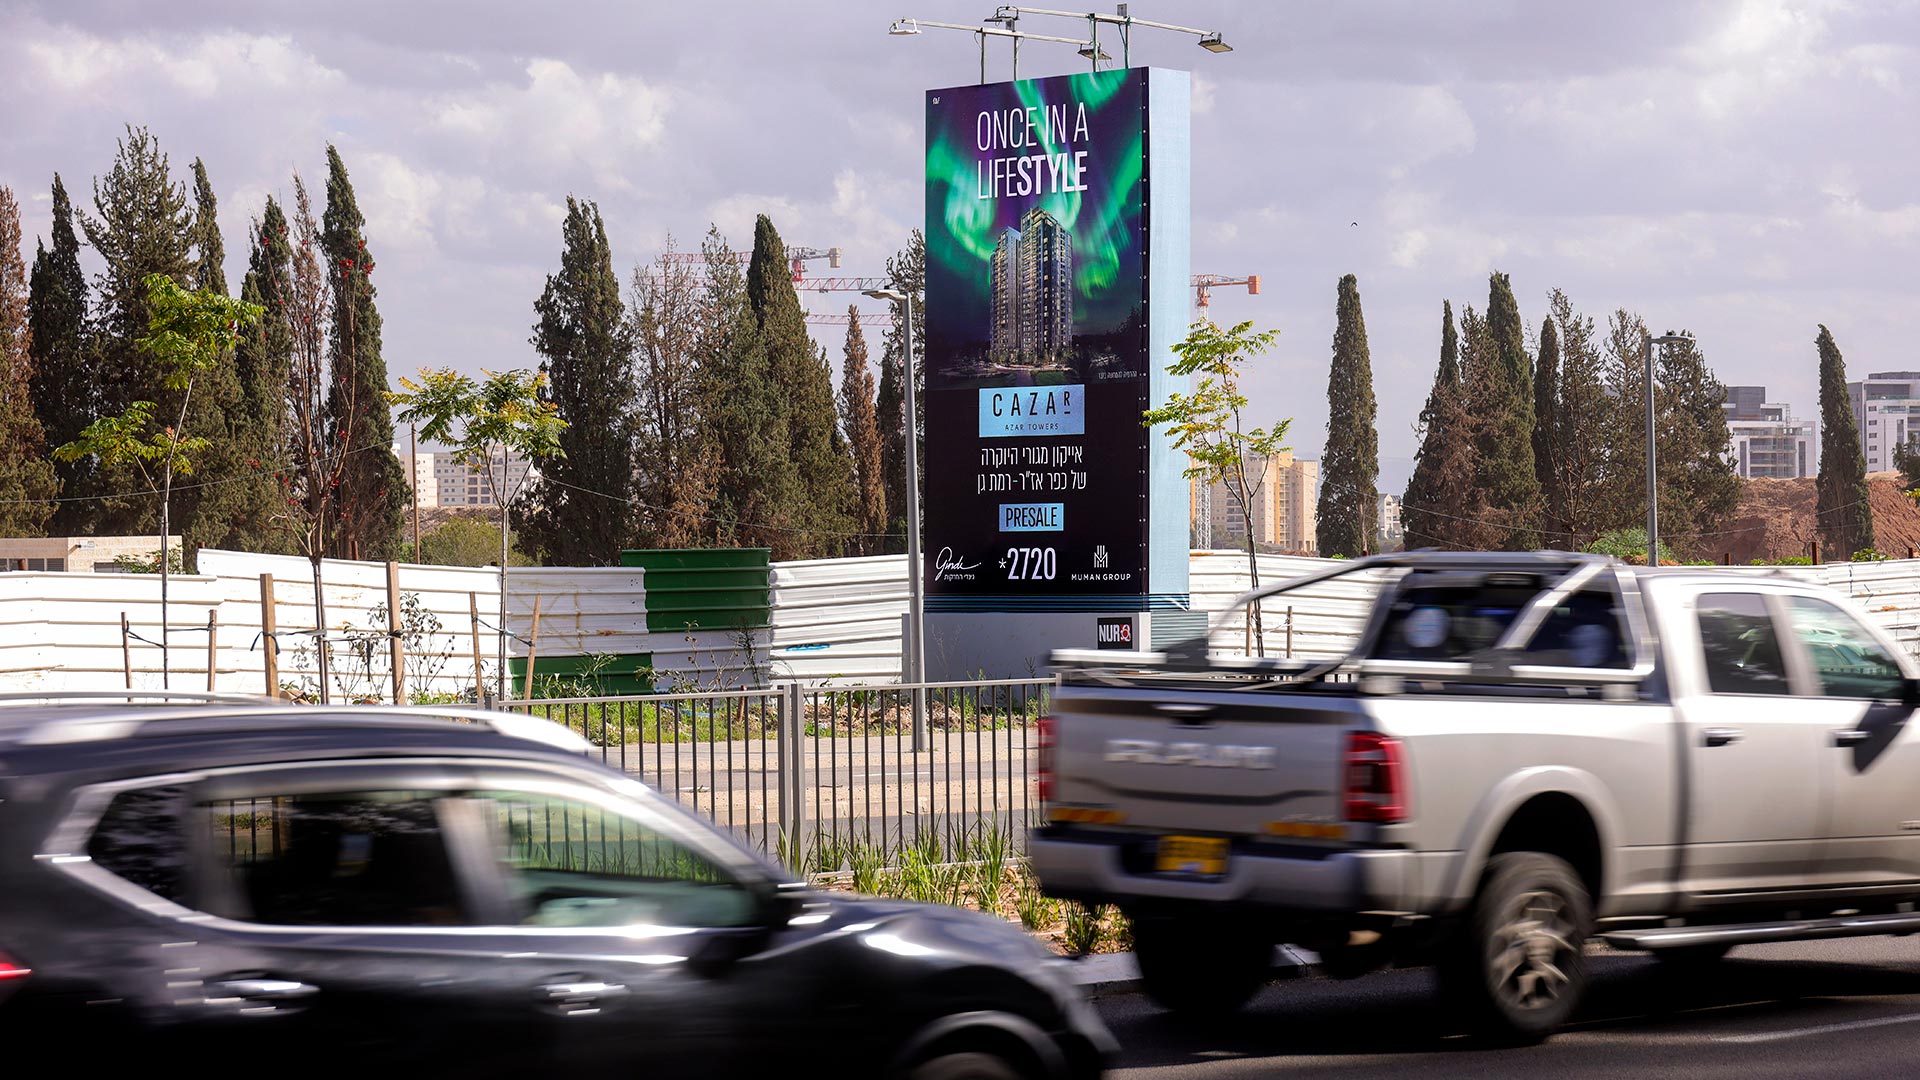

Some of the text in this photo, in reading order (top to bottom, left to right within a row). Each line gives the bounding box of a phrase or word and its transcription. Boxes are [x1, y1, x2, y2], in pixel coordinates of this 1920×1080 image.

[977, 102, 1089, 151] ONCE IN A
[977, 151, 1088, 199] LIFESTYLE
[992, 391, 1071, 417] CAZAR
[1005, 422, 1059, 431] AZAR TOWERS
[981, 445, 1083, 469] אייקון מגורי היוקרה
[977, 474, 986, 495] גן
[1047, 473, 1067, 491] כפר
[1071, 469, 1087, 490] של
[1005, 506, 1058, 527] PRESALE
[1102, 573, 1131, 581] GROUP
